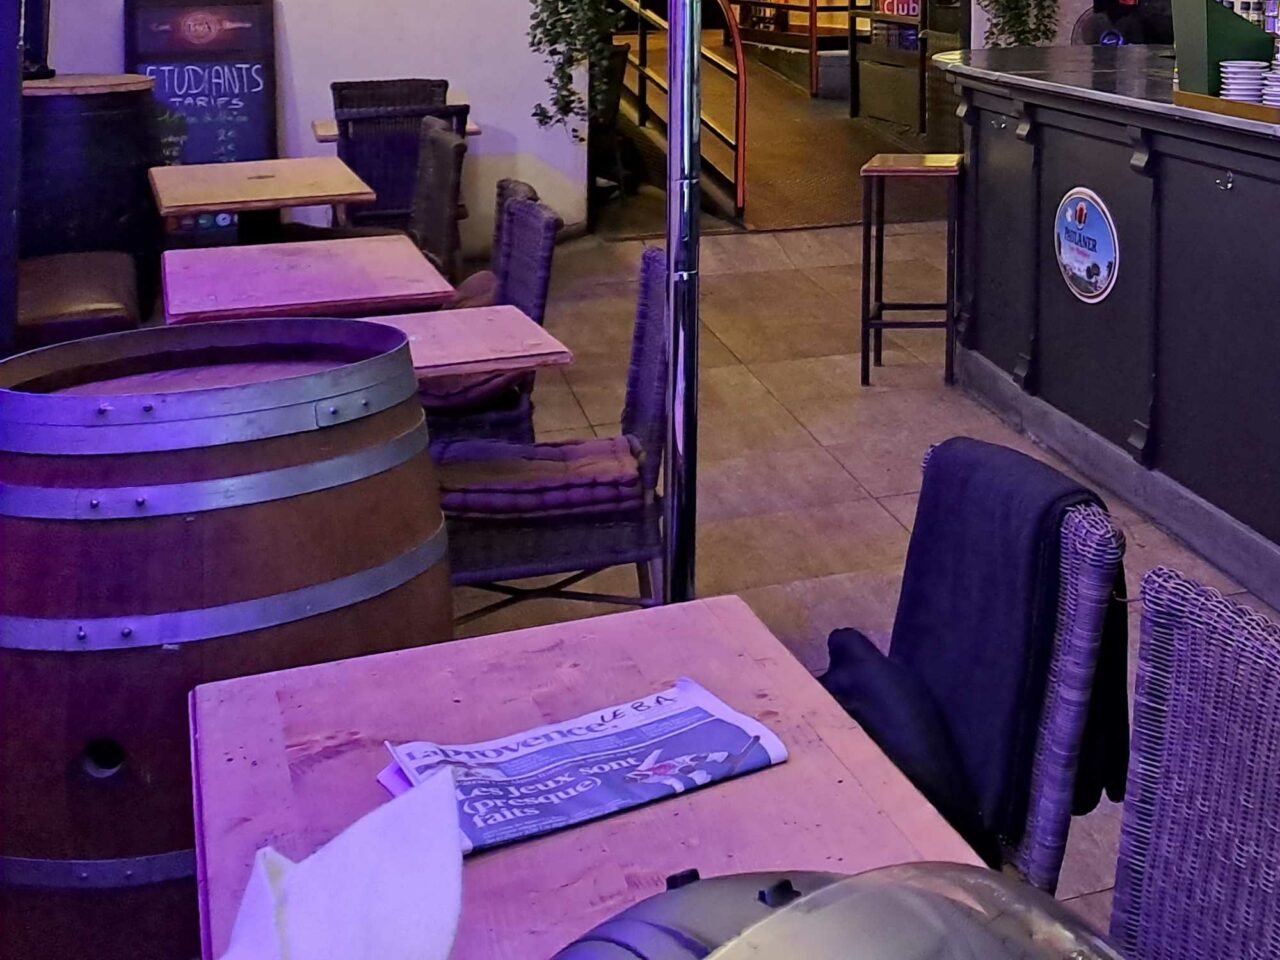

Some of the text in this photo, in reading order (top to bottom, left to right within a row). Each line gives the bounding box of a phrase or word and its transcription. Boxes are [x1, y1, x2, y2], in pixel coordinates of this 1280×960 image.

[884, 0, 919, 16] Club
[145, 64, 264, 96] ETUDIANTS
[170, 96, 244, 109] TARIFS
[578, 756, 645, 777] sont
[462, 776, 602, 815] (presque)
[472, 806, 541, 829] faits
